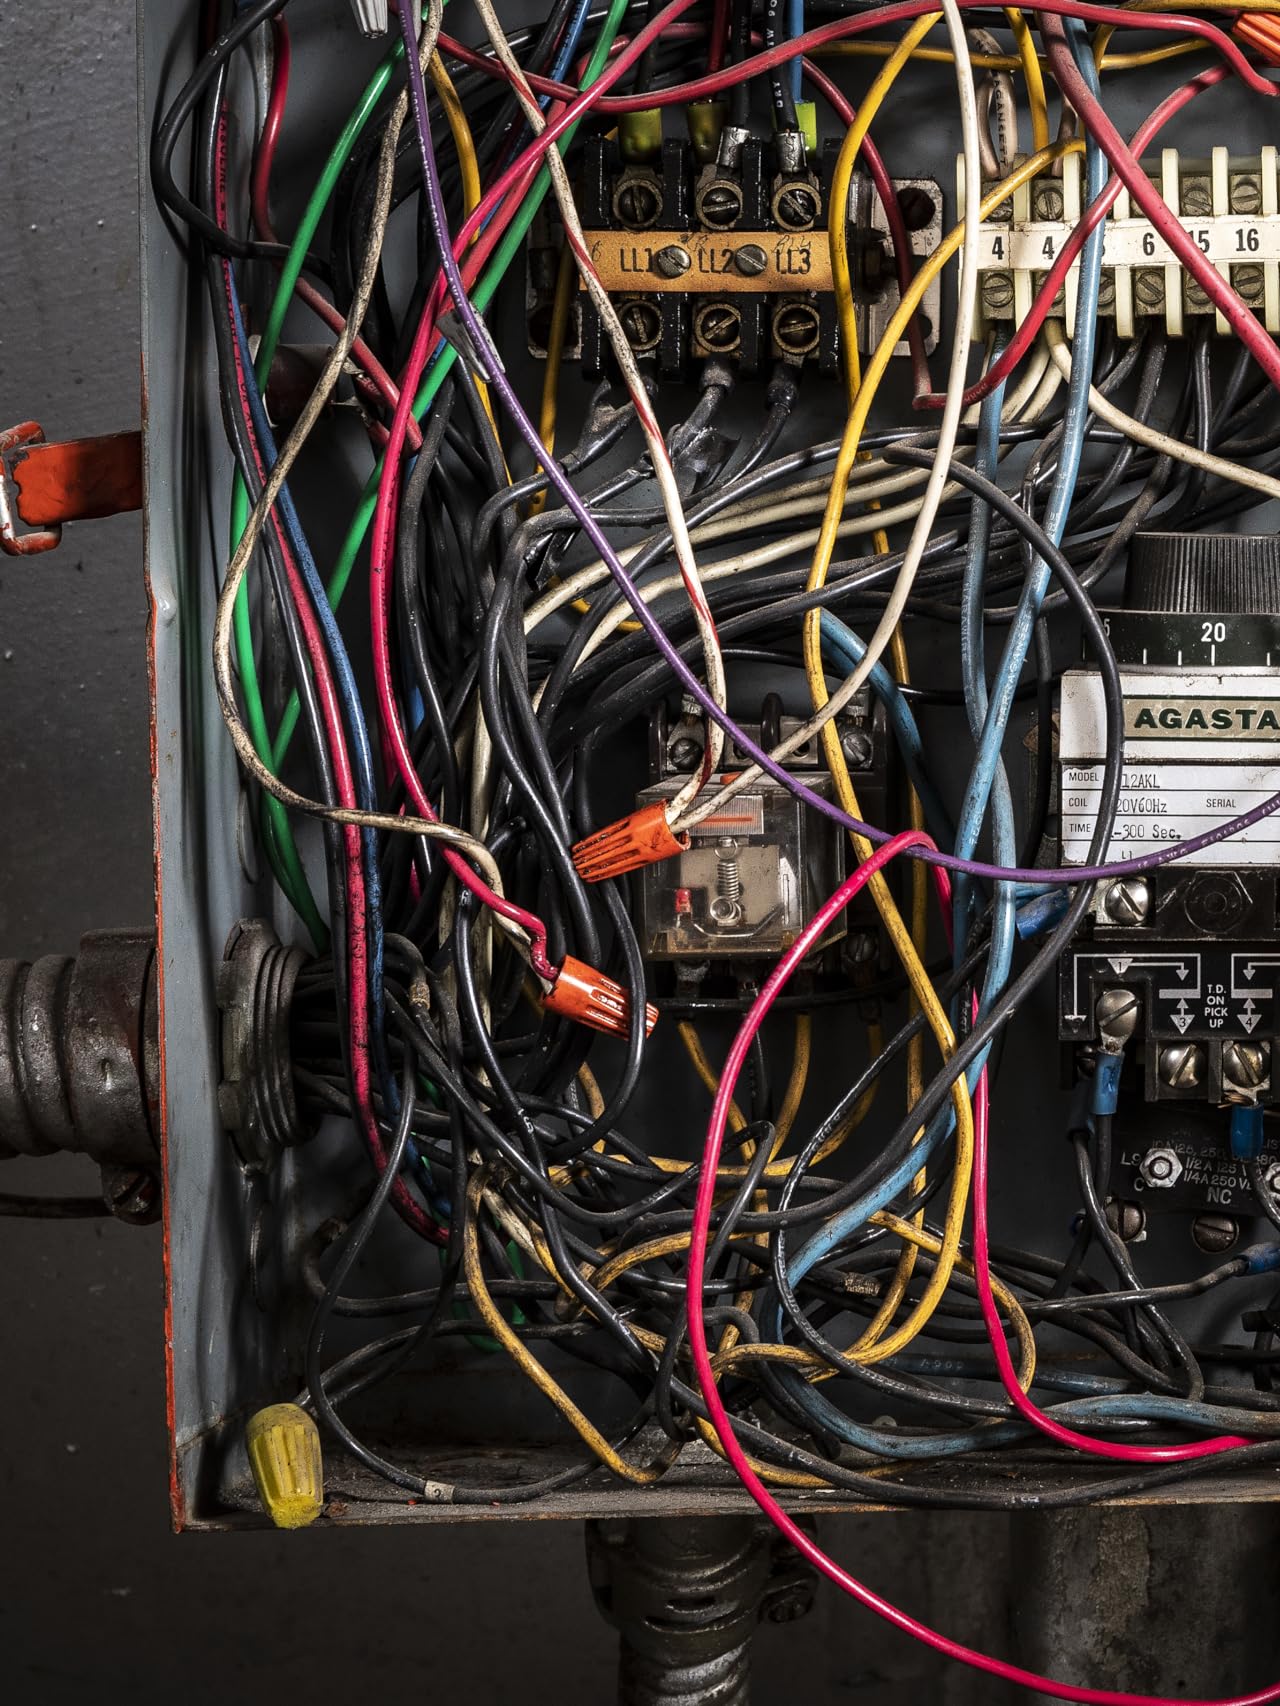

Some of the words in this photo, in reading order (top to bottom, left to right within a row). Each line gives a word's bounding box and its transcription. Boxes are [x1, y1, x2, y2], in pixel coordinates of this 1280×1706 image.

[991, 236, 1004, 259] 4
[1042, 236, 1055, 259] 4
[1142, 232, 1155, 256] 6
[1235, 227, 1260, 252] 16
[697, 248, 731, 274] LL2
[775, 248, 811, 275] LL3
[1200, 622, 1226, 642] 20
[1069, 772, 1100, 783] MODEL
[1068, 798, 1089, 808] COIL
[1206, 798, 1237, 808] SERIAL
[1069, 823, 1092, 833] TIME
[1153, 824, 1182, 839] Sec.
[1207, 984, 1227, 994] T.D.
[1207, 995, 1225, 1005] ON
[1204, 1007, 1229, 1017] PICK
[1209, 1019, 1224, 1029] UP
[1207, 1186, 1232, 1205] NC
